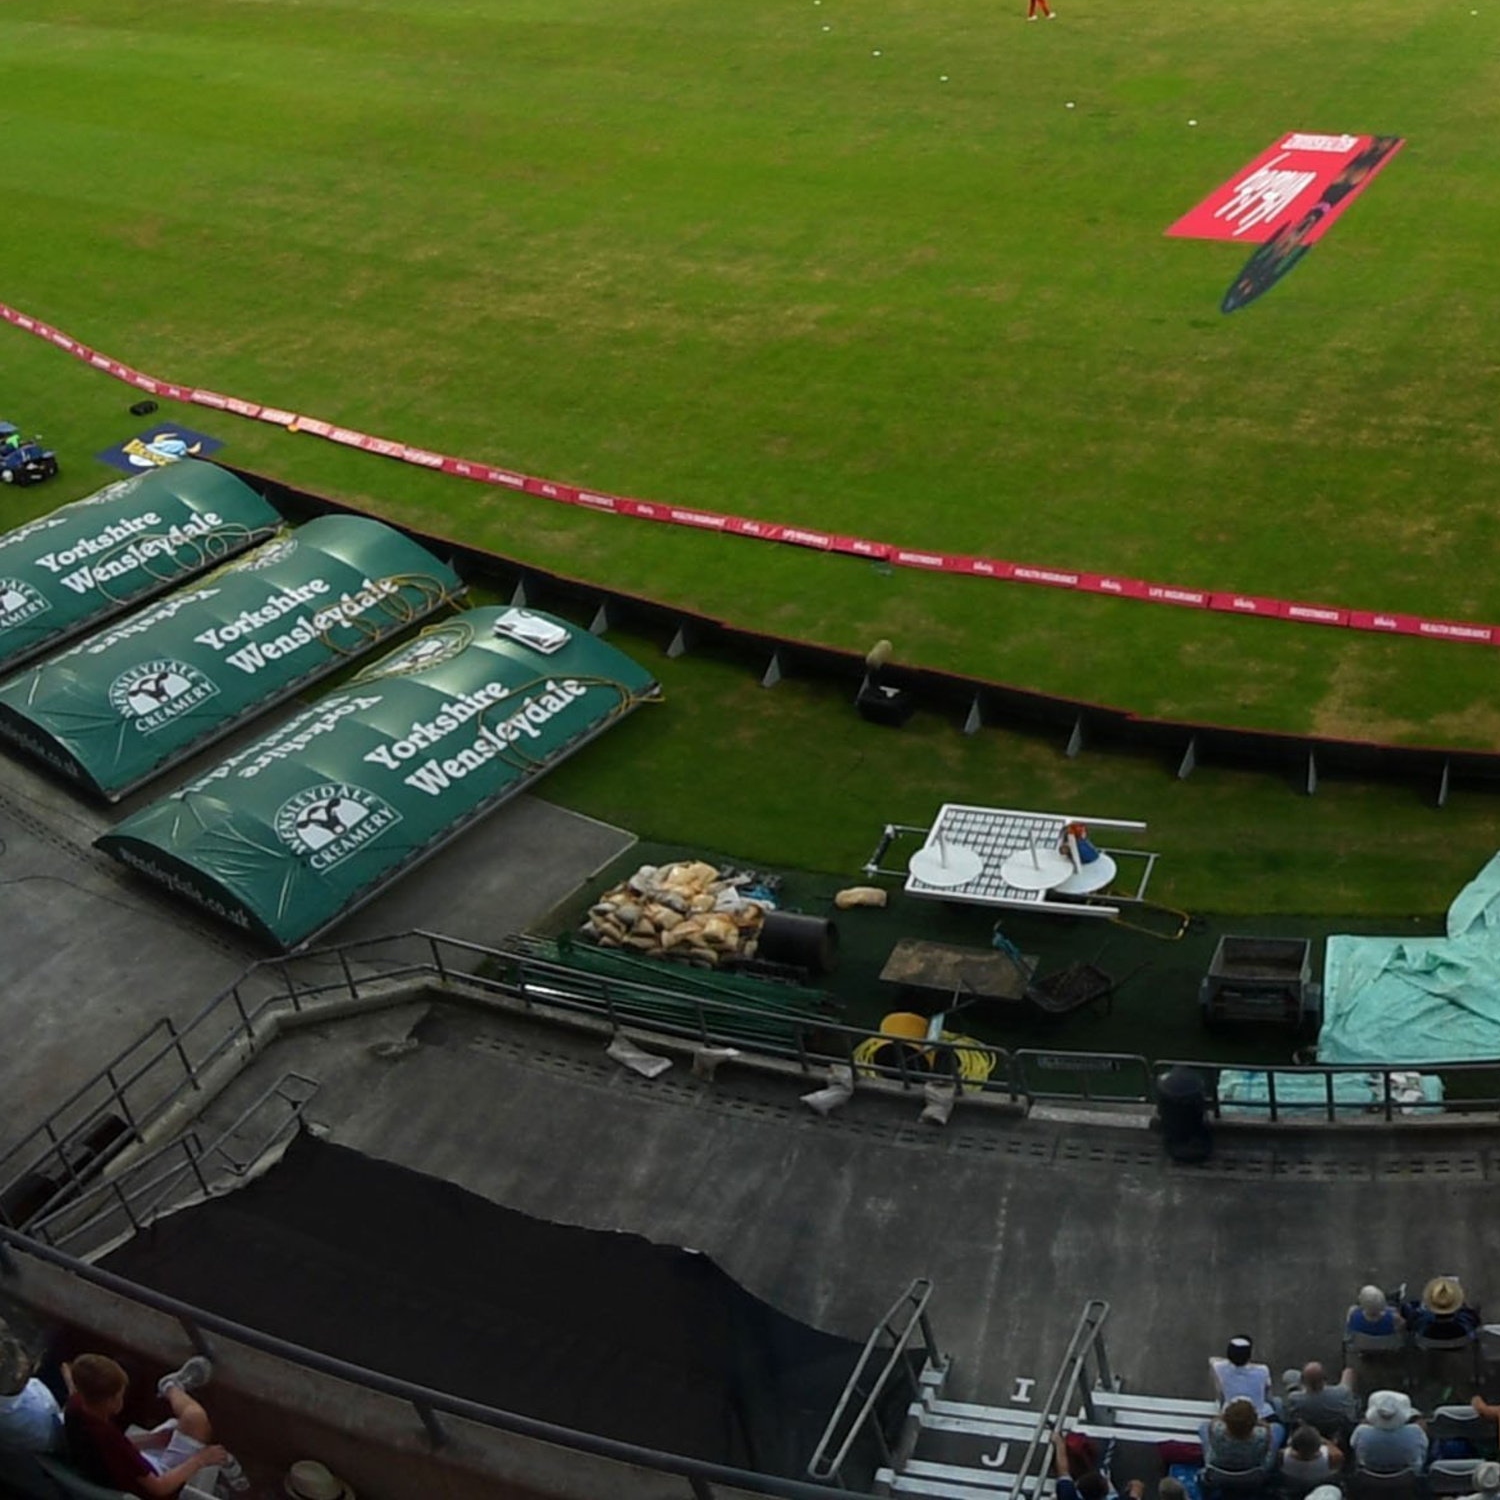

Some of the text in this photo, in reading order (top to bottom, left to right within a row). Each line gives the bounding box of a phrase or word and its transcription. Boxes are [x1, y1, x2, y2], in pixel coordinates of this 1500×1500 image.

[35, 511, 162, 573] Yorkshire
[60, 512, 223, 595] Wensleydale
[0, 600, 45, 627] AMERY
[194, 577, 330, 651] Yorkshire
[225, 578, 399, 674] Wensleydale
[1420, 622, 1491, 639] HEALTH INSURANCE
[113, 662, 198, 720] WENSLEYDALE
[135, 682, 214, 732] CREAMERY
[238, 696, 384, 779] Yorkshire
[364, 681, 510, 770] Yorkshire
[404, 679, 588, 797] Wensleydale
[278, 784, 374, 856] WENSLEYDALE
[309, 806, 396, 870] CREAMERY
[1011, 1377, 1036, 1403] I
[981, 1442, 1008, 1467] J
